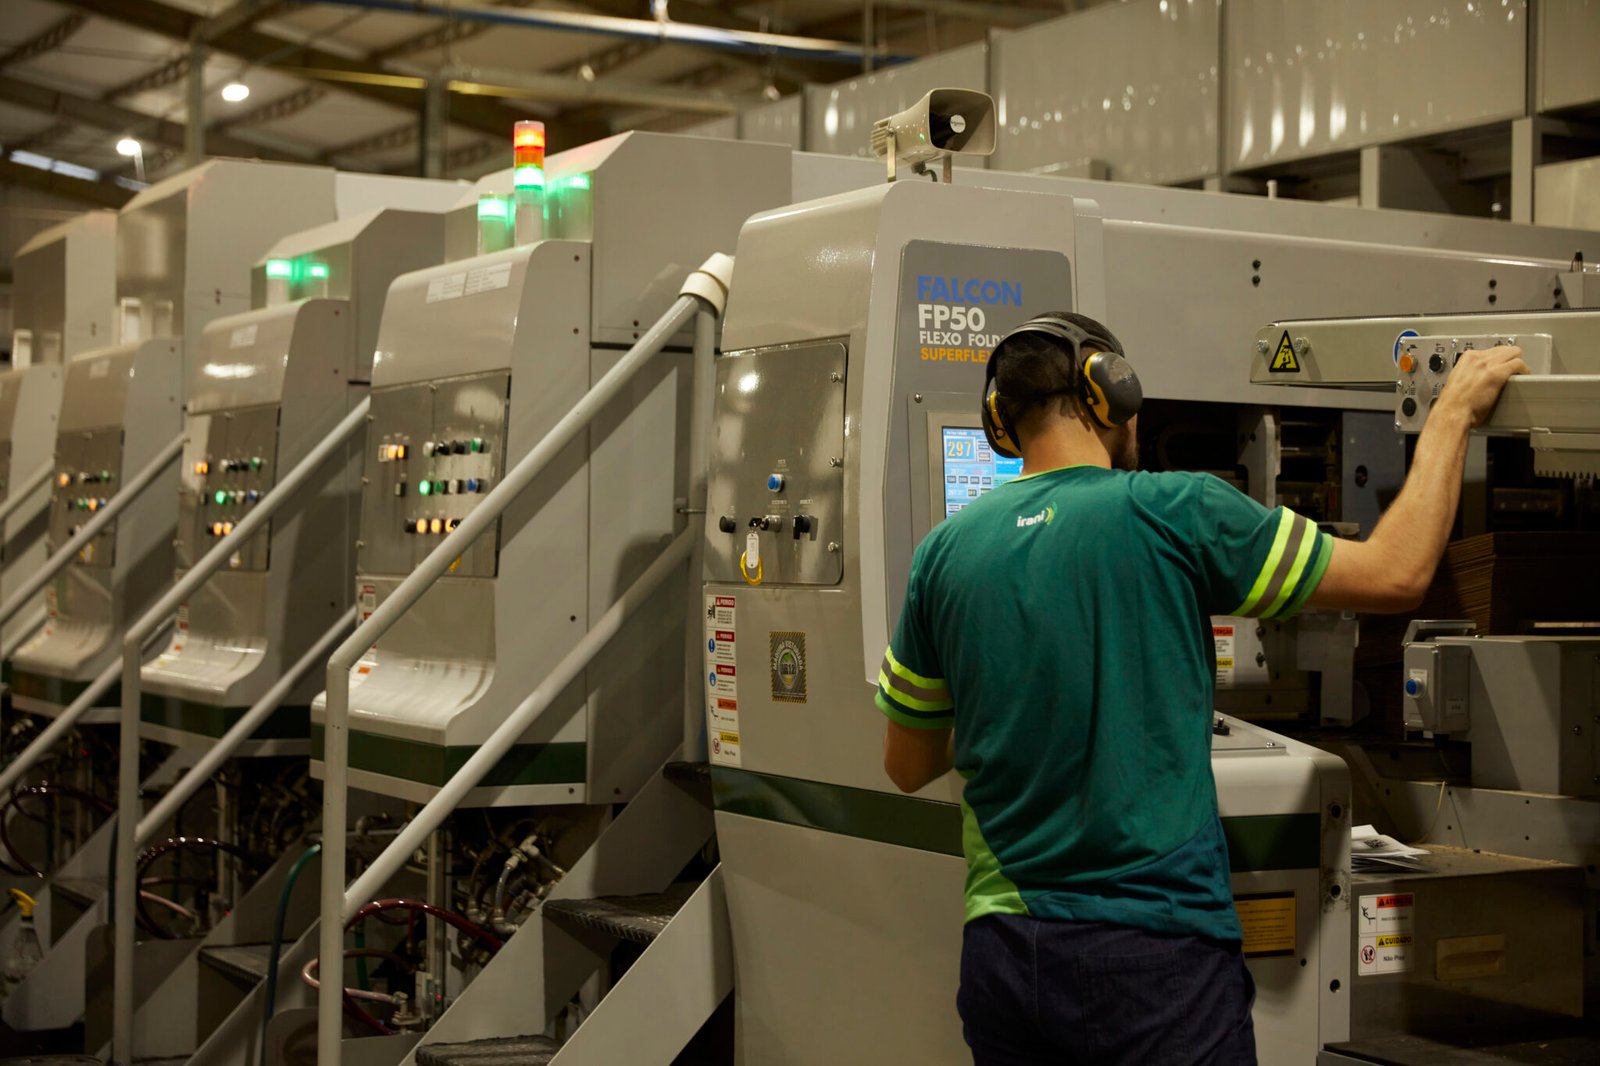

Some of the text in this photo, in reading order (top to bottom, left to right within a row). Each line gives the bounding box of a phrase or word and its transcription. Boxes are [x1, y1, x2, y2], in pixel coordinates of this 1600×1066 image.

[917, 274, 1023, 307] FALCON
[918, 303, 986, 332] FP50
[919, 330, 1005, 348] FLEXO FOLD
[947, 441, 972, 457] 297
[1016, 510, 1046, 528] irani
